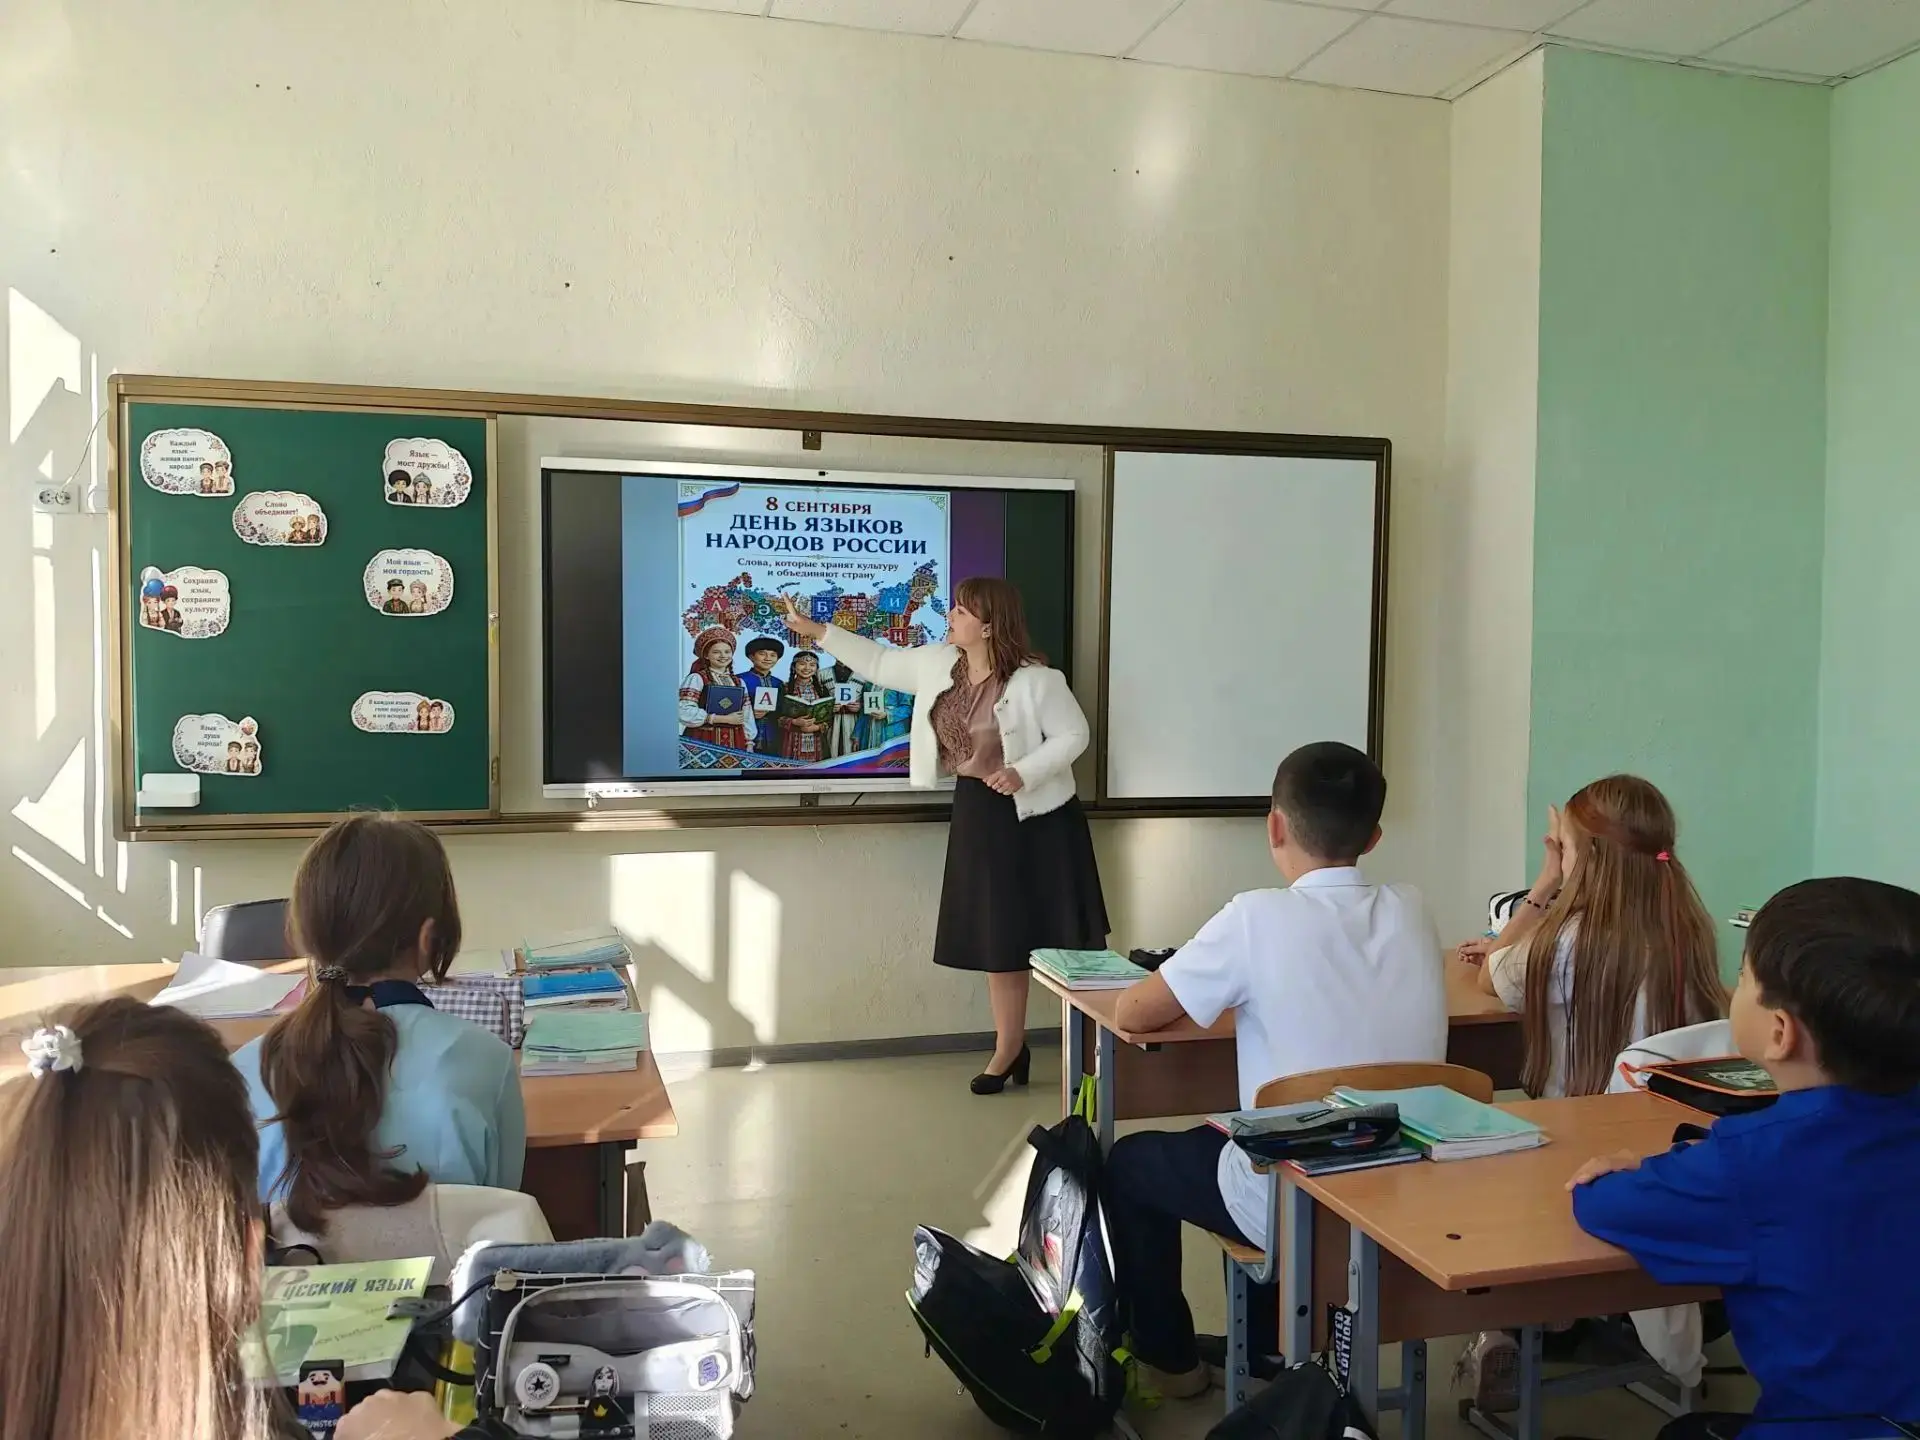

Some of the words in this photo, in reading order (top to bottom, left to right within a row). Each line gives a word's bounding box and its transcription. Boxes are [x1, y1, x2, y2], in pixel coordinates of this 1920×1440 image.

[409, 450, 429, 458] Язык
[417, 461, 450, 470] дружбы!
[254, 508, 299, 516] объединяет!
[765, 497, 778, 511] 8
[785, 500, 872, 515] СЕНТЯБРЯ
[730, 514, 797, 532] ДЕНЬ
[804, 516, 903, 535] ЯЗЫКОВ
[705, 533, 824, 552] НАРОДОВ
[833, 537, 927, 555] РОССИИ
[386, 558, 401, 566] Мой
[737, 557, 772, 568] Слова,
[774, 560, 818, 570] которые
[820, 561, 854, 572] хранят
[857, 562, 899, 572] культуру
[776, 569, 840, 578] объединяют
[842, 571, 875, 580] страну
[817, 601, 828, 613] Б
[759, 692, 773, 705] А
[840, 688, 852, 701] Б
[1340, 1314, 1352, 1377] EDITION
